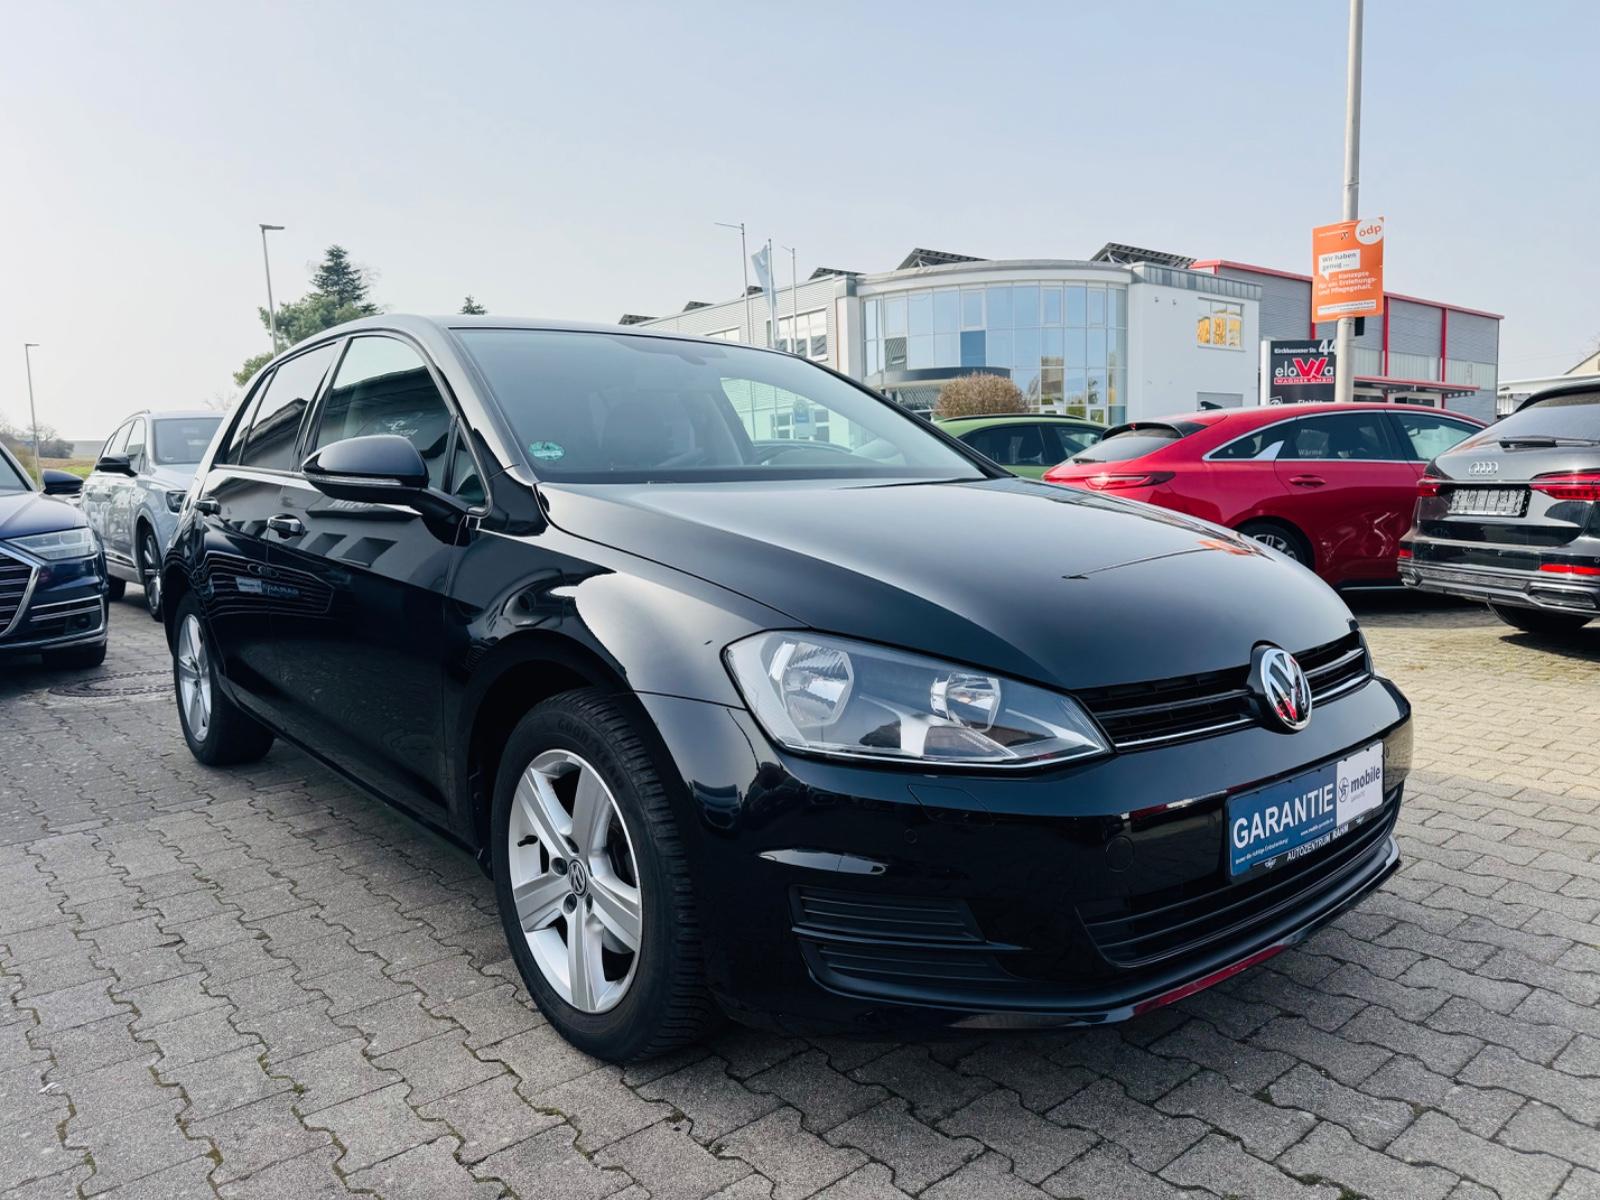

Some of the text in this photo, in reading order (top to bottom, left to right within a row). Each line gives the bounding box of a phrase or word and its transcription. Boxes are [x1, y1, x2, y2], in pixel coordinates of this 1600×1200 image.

[1335, 252, 1357, 260] haben
[1351, 766, 1381, 793] mobile
[1233, 783, 1334, 849] GARANTIE
[1287, 832, 1331, 862] AUTOZENTRUM
